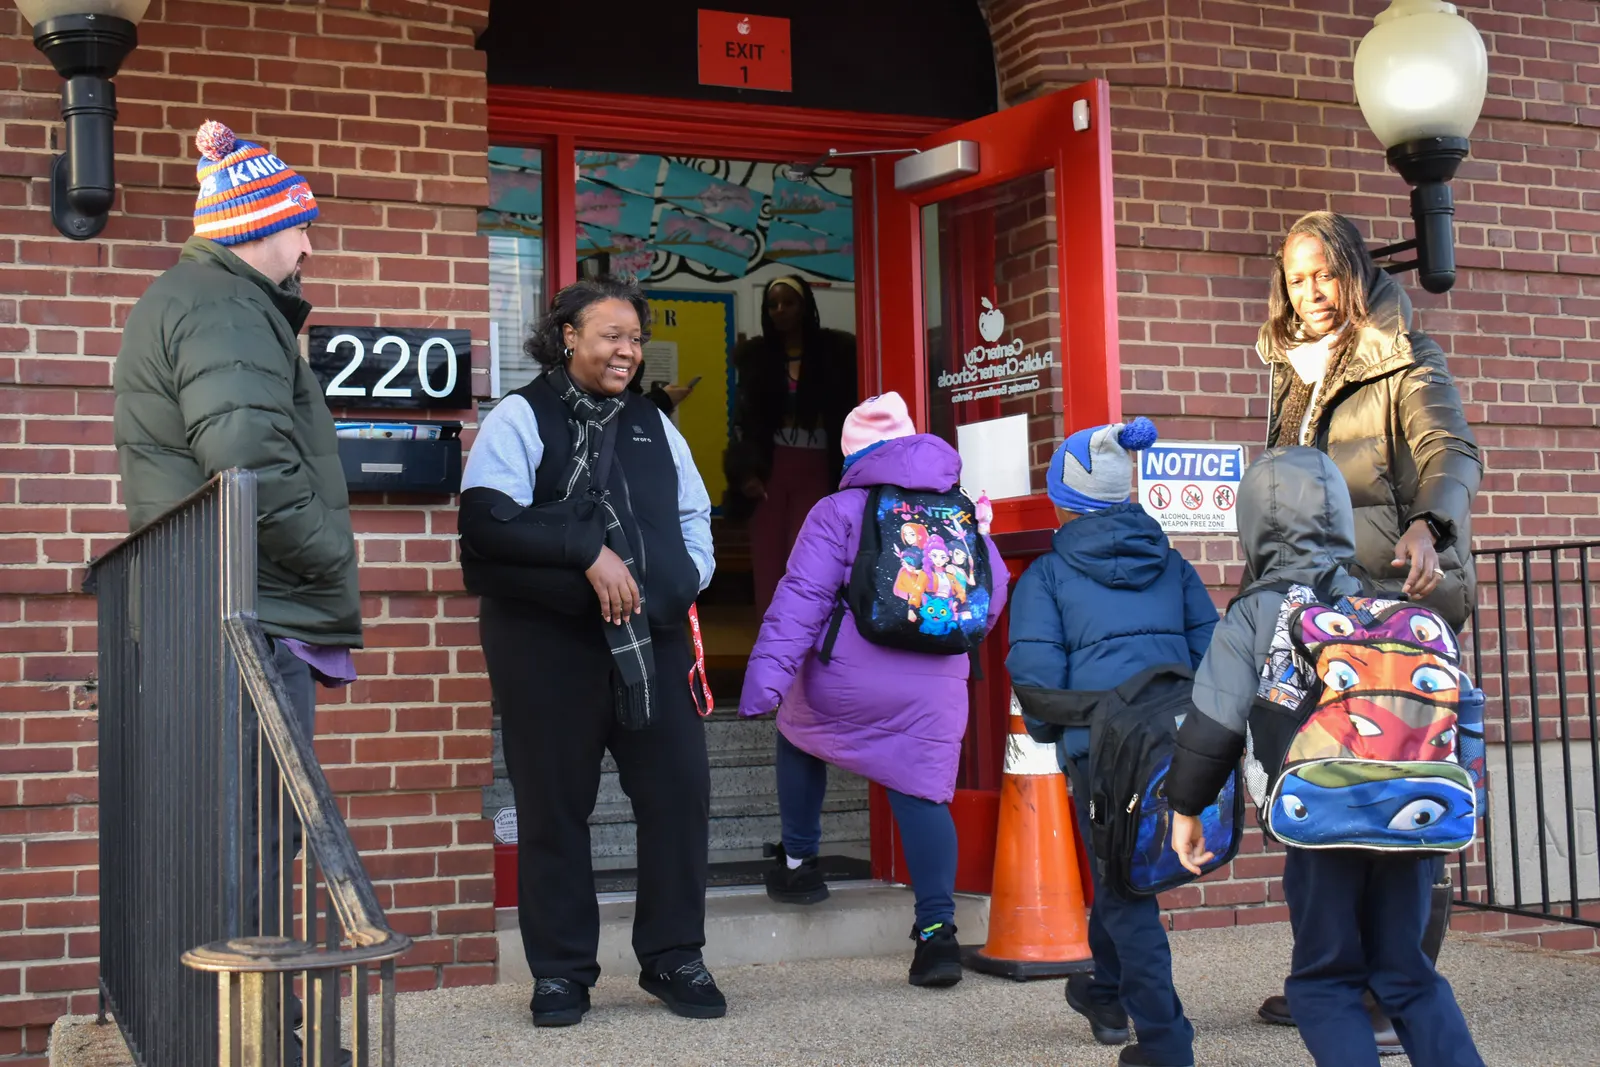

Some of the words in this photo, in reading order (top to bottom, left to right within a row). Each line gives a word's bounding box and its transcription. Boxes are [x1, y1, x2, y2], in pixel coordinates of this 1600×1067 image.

[725, 41, 765, 61] EXIT
[740, 66, 748, 83] 1
[227, 154, 289, 187] KNIC
[325, 334, 458, 398] 220
[1146, 453, 1235, 477] NOTICE
